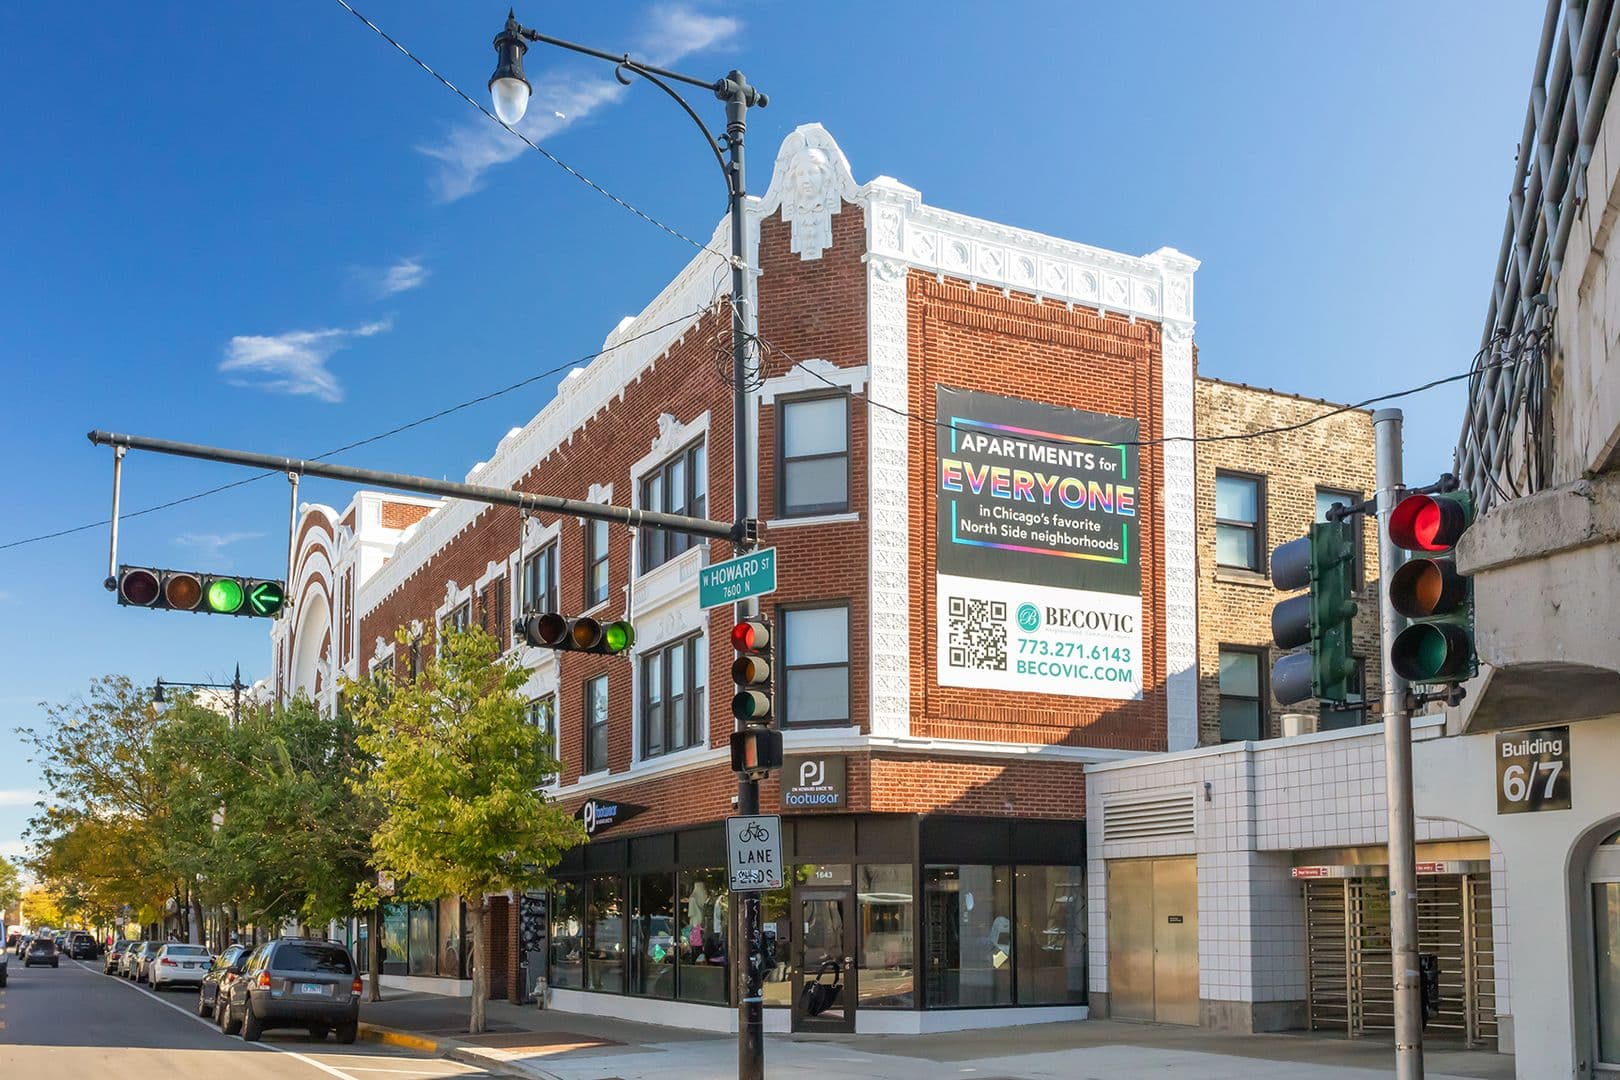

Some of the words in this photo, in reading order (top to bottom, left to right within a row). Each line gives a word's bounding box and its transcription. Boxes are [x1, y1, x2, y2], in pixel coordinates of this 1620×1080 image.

[960, 433, 1095, 471] APARTMENTS
[1099, 457, 1118, 472] for
[942, 458, 1136, 517] EVERYONE
[979, 504, 991, 518] in
[993, 506, 1050, 527] Chicago's
[1052, 514, 1101, 532] favorite
[960, 519, 998, 536] North
[1001, 524, 1027, 539] Side
[1031, 526, 1120, 551] neighborhoods
[703, 574, 709, 587] W
[711, 559, 759, 587] HOWARD
[761, 556, 770, 570] ST
[723, 583, 742, 598] 7600
[744, 580, 751, 593] N
[1045, 606, 1134, 634] BECOVIC
[1017, 638, 1131, 663] 773.271.6143
[1016, 660, 1133, 683] BECOVIC.COM
[1502, 738, 1563, 758] Building
[800, 760, 825, 787] PJ
[1503, 760, 1564, 802] 6/7
[785, 792, 839, 805] footwear
[584, 801, 596, 833] PJ
[738, 849, 773, 864] LANE
